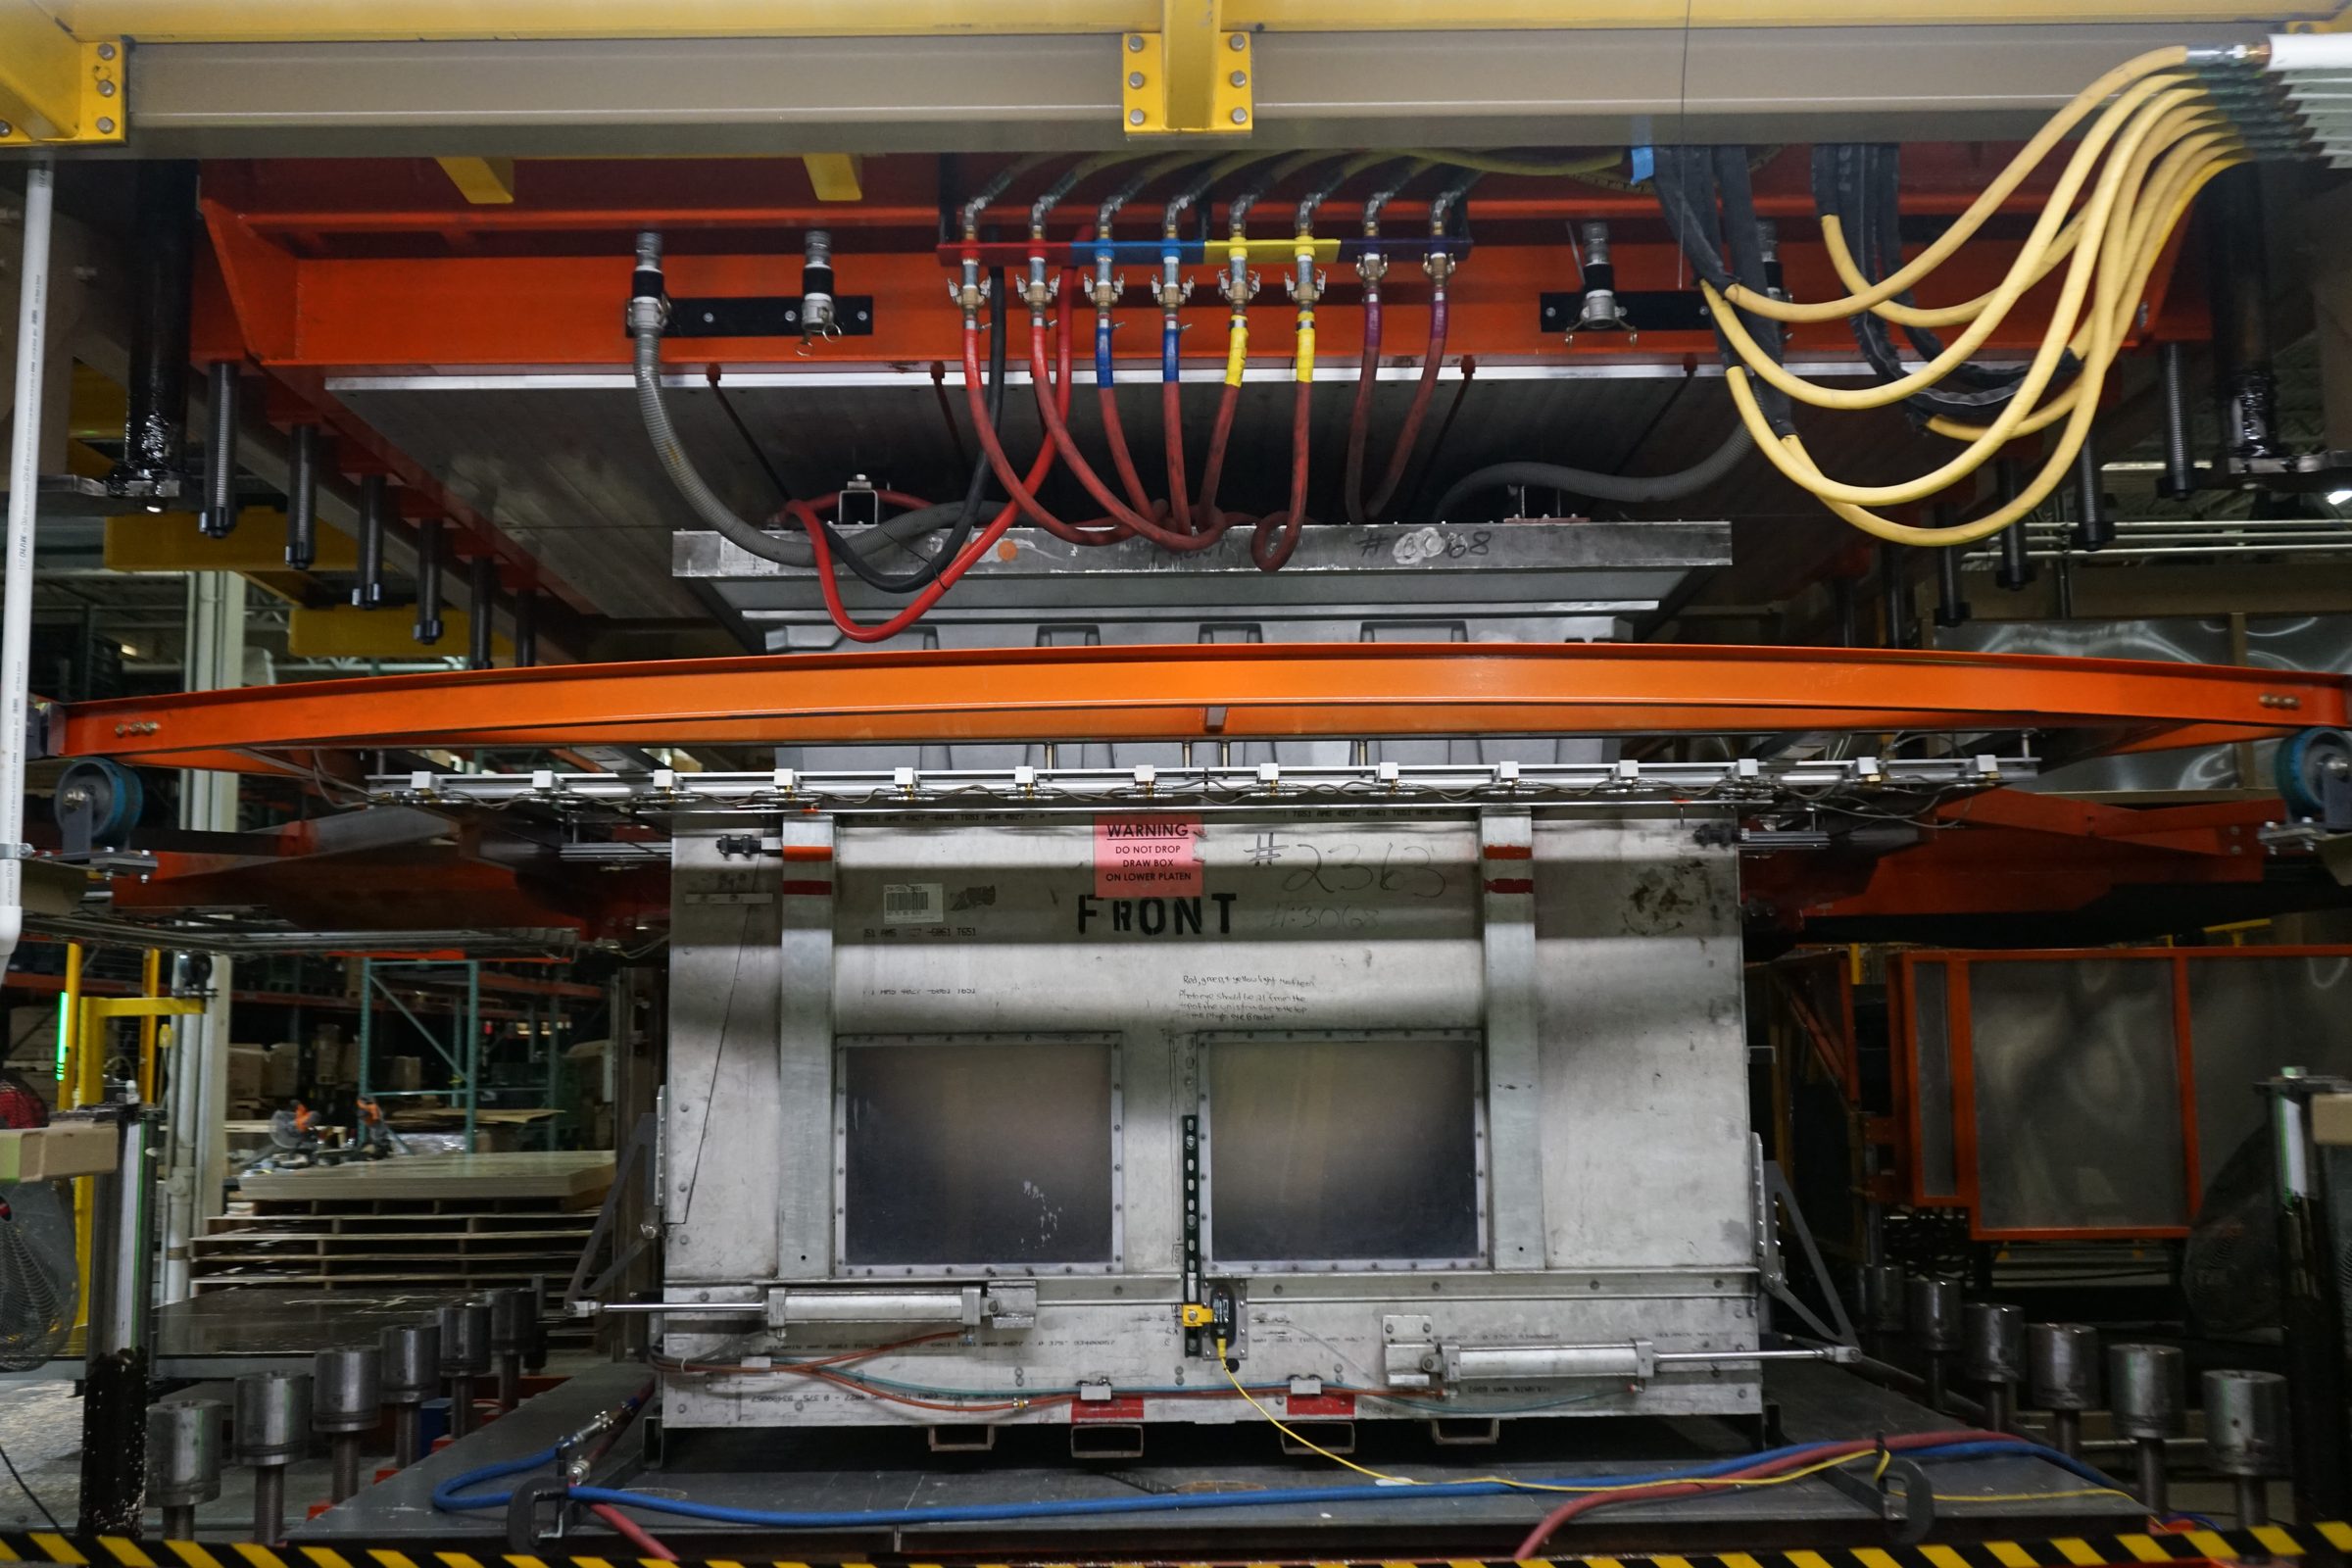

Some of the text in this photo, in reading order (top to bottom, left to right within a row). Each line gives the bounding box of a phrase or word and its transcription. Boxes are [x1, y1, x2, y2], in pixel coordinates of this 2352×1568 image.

[1106, 822, 1189, 837] WARNING
[1115, 845, 1181, 855] DO NOT DROP
[1123, 858, 1174, 868] DRAW BOX
[1105, 871, 1192, 882] ON LOWER PLATEN
[1078, 893, 1237, 936] FRONT
